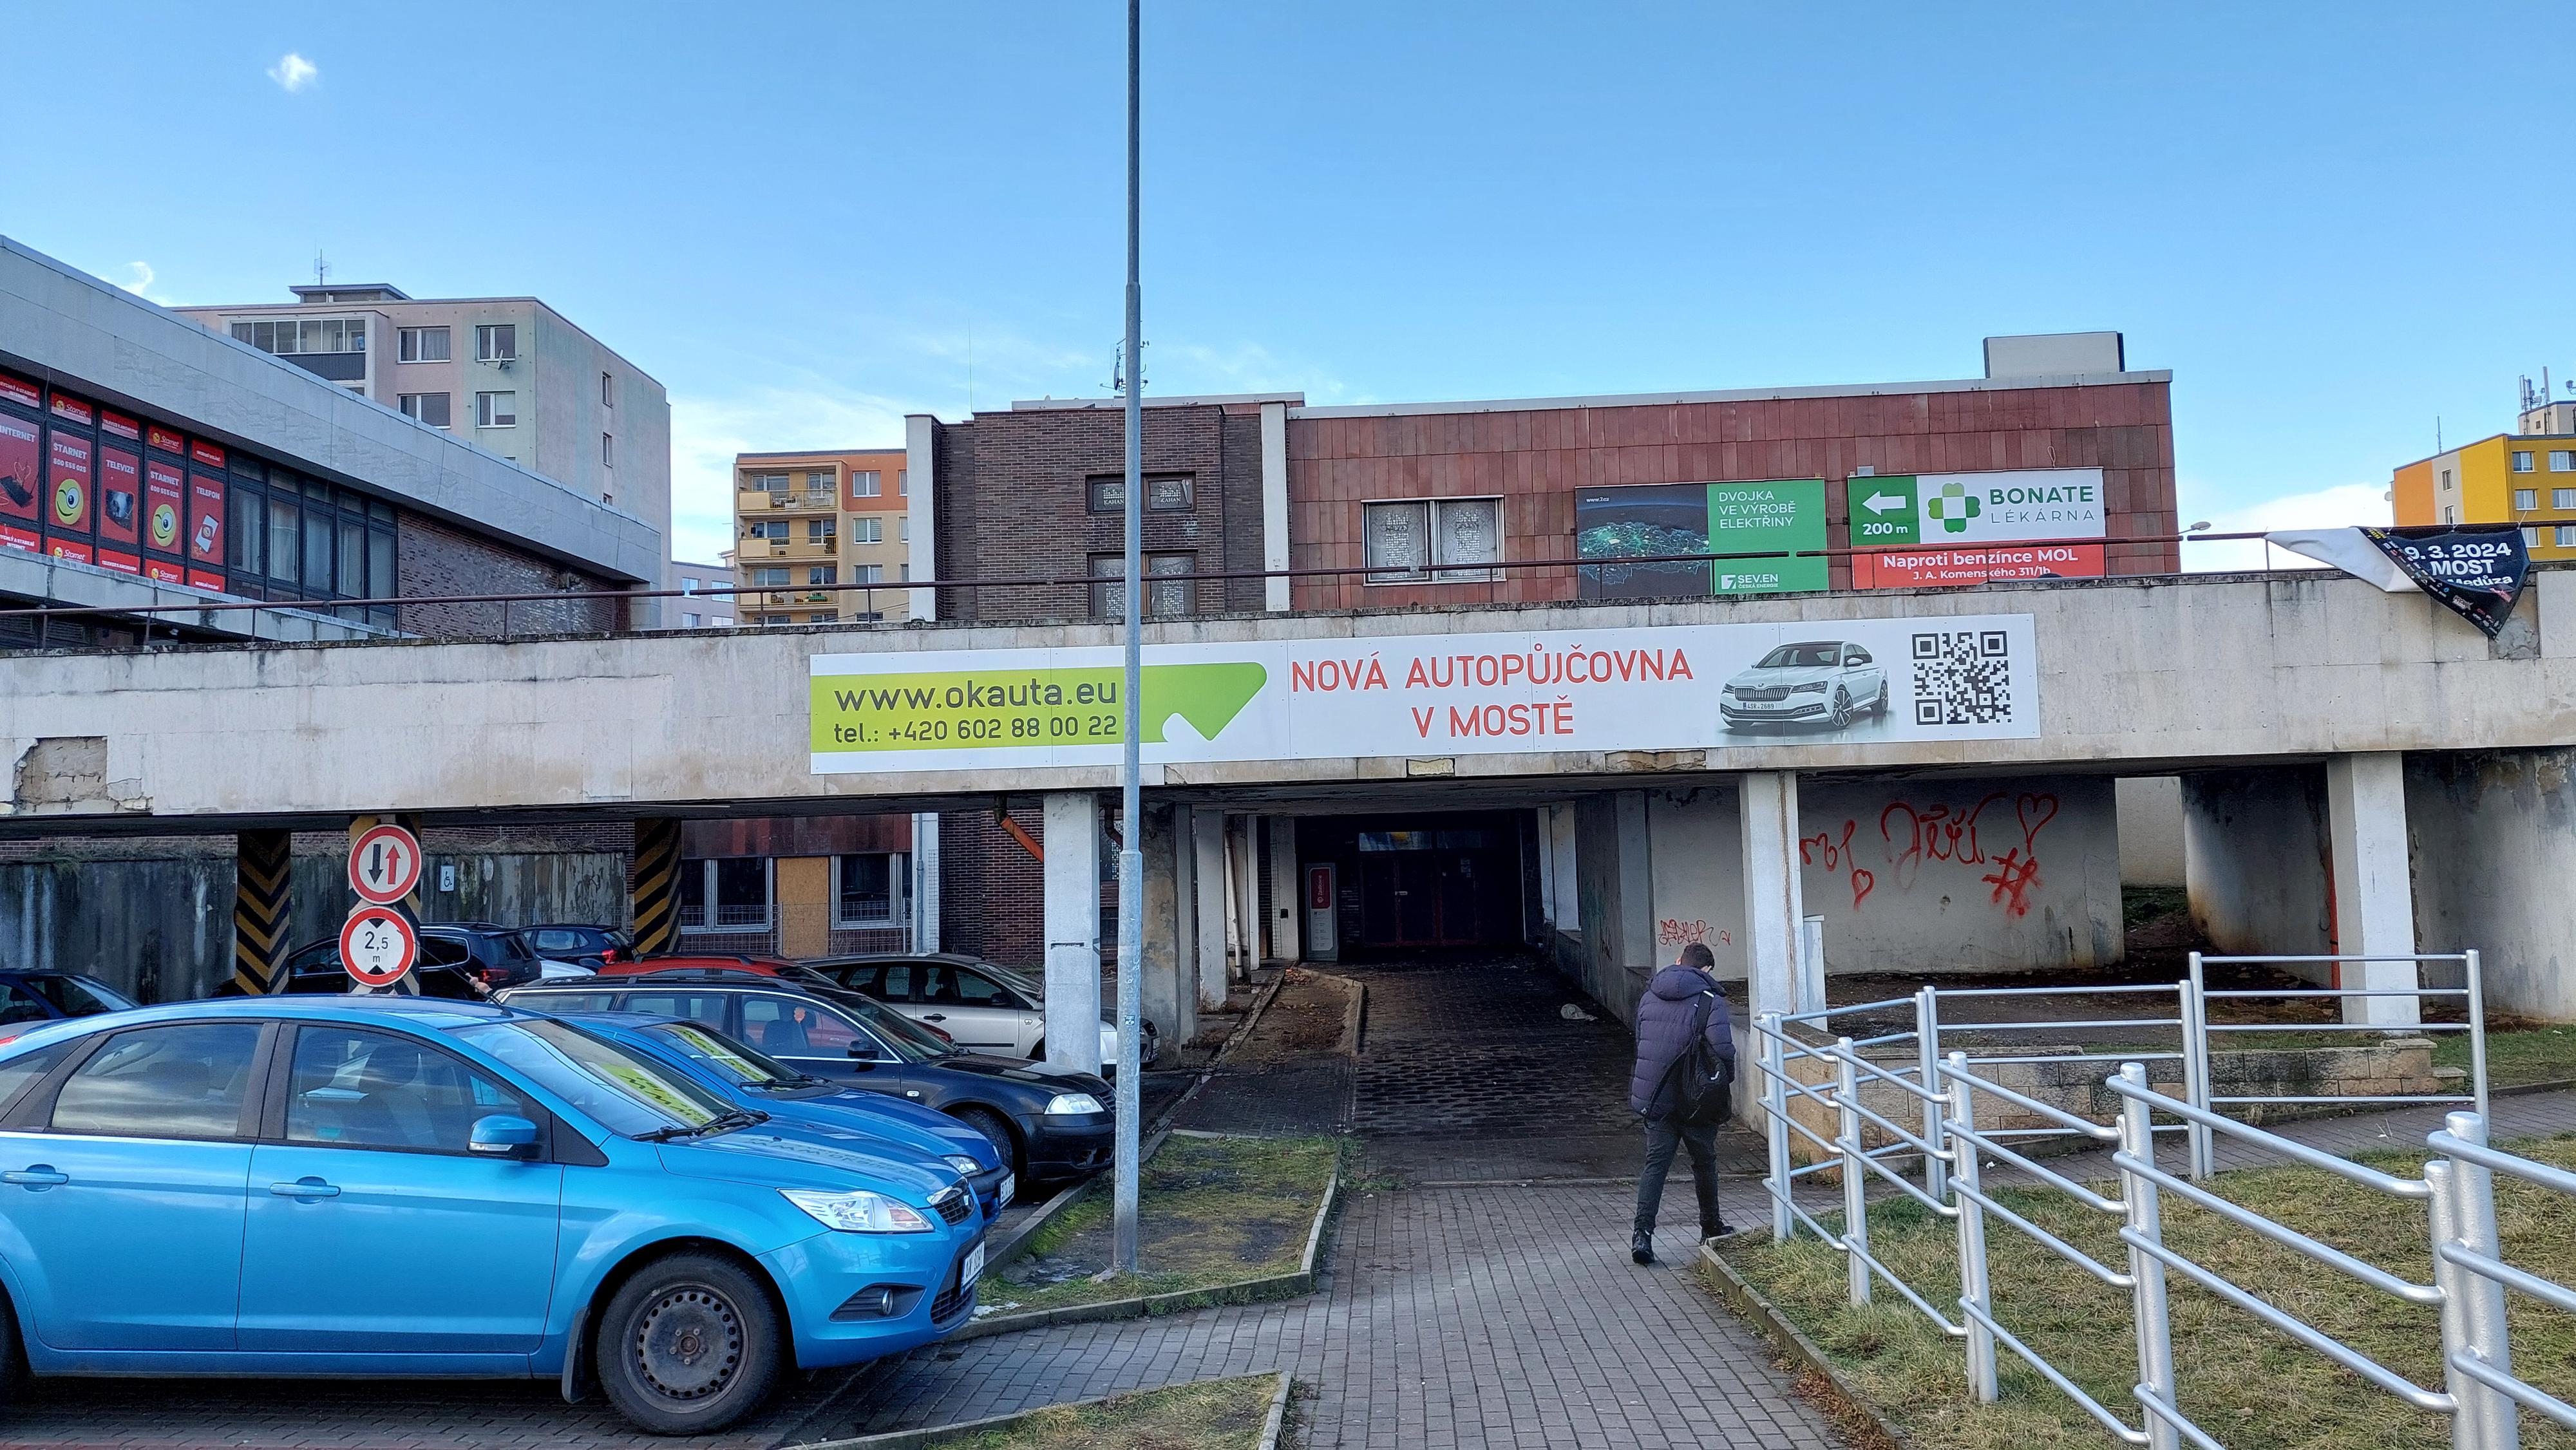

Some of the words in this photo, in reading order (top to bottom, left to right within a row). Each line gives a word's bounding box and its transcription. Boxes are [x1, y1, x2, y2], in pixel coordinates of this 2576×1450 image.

[0, 425, 35, 443] INTERNET
[53, 442, 87, 460] STARNET
[106, 459, 135, 475] TELEVIZE
[150, 471, 179, 486] STARNET
[196, 486, 220, 500] TELEFON
[1719, 490, 1775, 503] DVOJKA
[1989, 485, 2094, 506] BONATE
[1719, 505, 1737, 516] VE
[1741, 500, 1796, 515] VÝROBĚ
[1719, 515, 1794, 529] ELEKTŘINY
[1991, 509, 2095, 524] LÉKÁRNA
[1862, 522, 1893, 536] 200
[1895, 525, 1908, 534] m
[2428, 545, 2449, 559] 3.
[2452, 542, 2512, 558] 2024
[1884, 552, 1948, 570] Naproti
[1953, 551, 2032, 565] benzínce
[2038, 549, 2078, 562] MOL
[2430, 559, 2494, 576] MOST
[1738, 574, 1779, 583] SEV.EN
[1913, 571, 1922, 579] J.
[1925, 570, 1937, 579] A.
[1940, 567, 2016, 579] Komenského
[1291, 650, 1389, 693] NOVÁ
[1405, 643, 1694, 690] AUTOPŮJČOVNA
[834, 678, 1118, 712] www.okauta.eu
[1411, 706, 1435, 739] V
[1450, 694, 1574, 738] MOSTĚ
[834, 722, 880, 744] tel.:
[888, 719, 949, 742] +420
[957, 718, 1002, 740] 602
[1010, 717, 1041, 739] 88
[1049, 715, 1079, 737] 00
[1088, 714, 1118, 737] 22
[365, 930, 389, 952] 2,5
[372, 955, 381, 963] m
